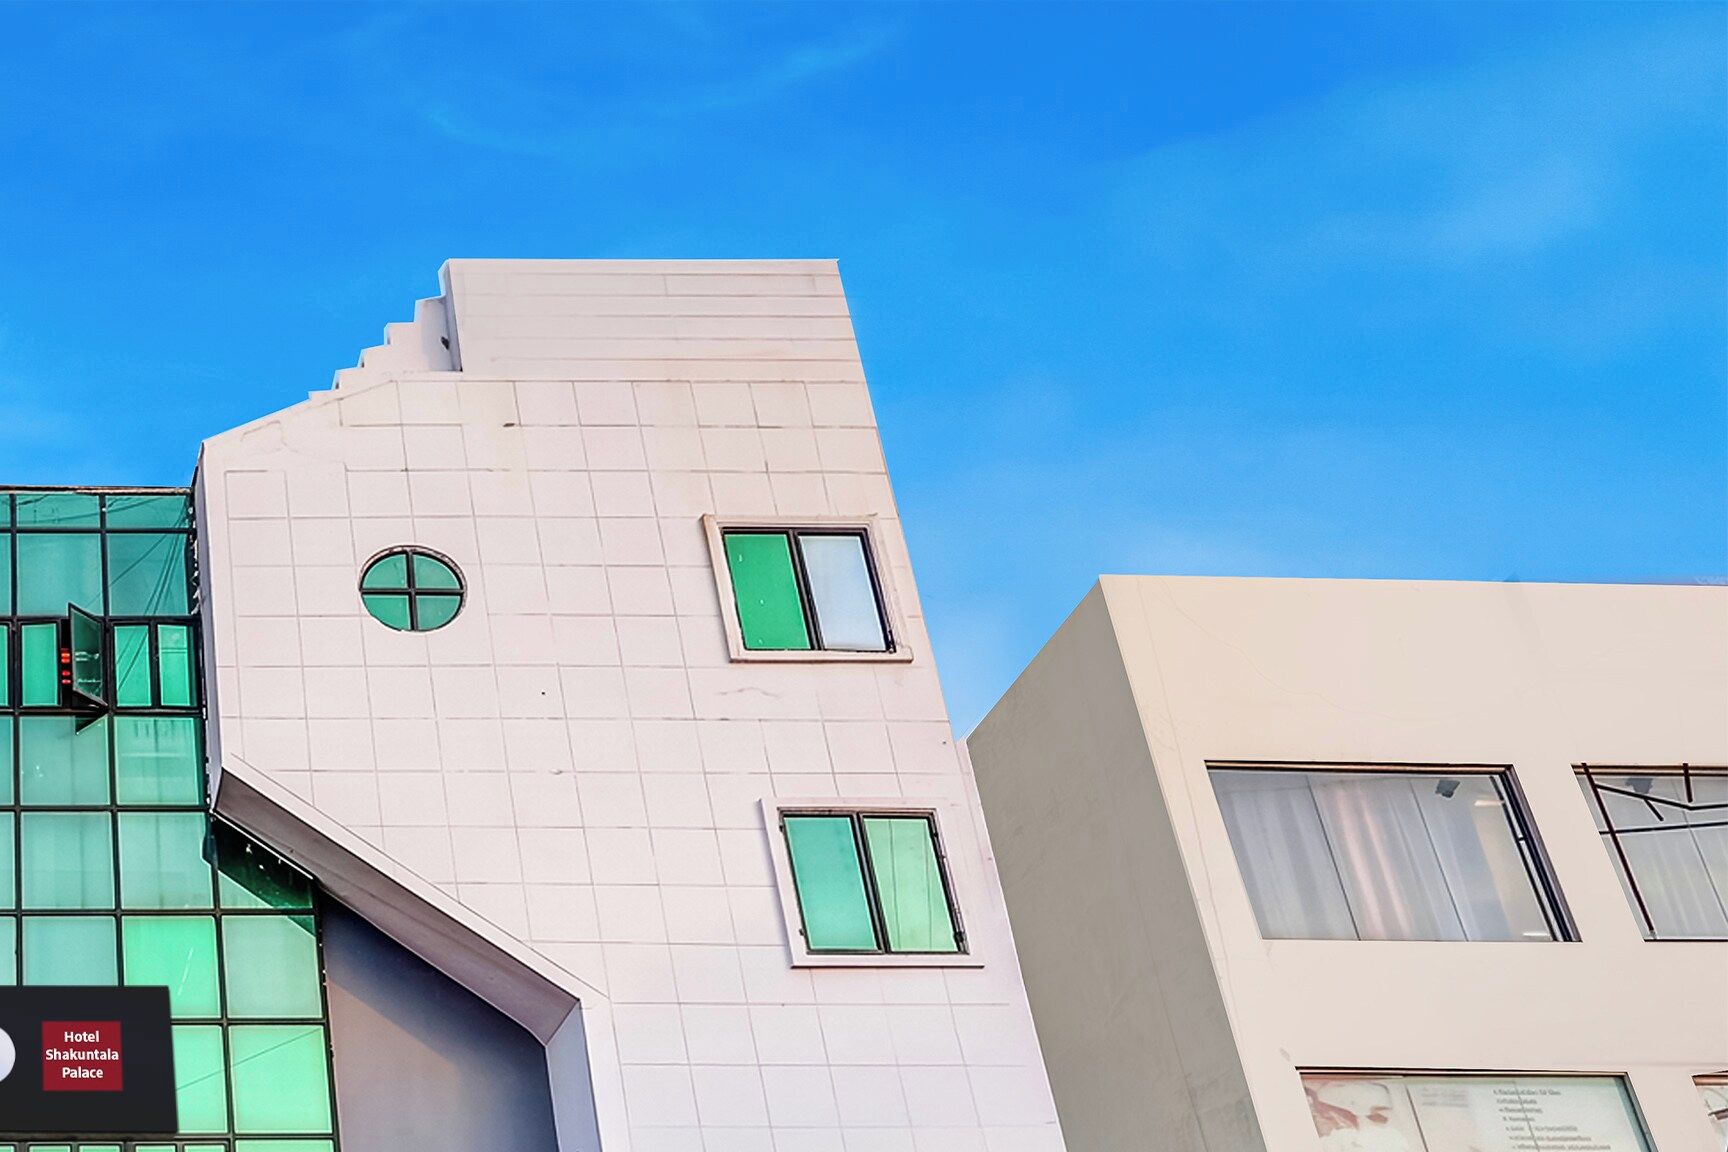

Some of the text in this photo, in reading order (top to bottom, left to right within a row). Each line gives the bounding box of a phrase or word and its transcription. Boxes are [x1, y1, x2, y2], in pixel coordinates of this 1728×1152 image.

[64, 1030, 100, 1043] Hotel
[45, 1047, 119, 1061] Shakuntala
[62, 1065, 104, 1079] Palace
